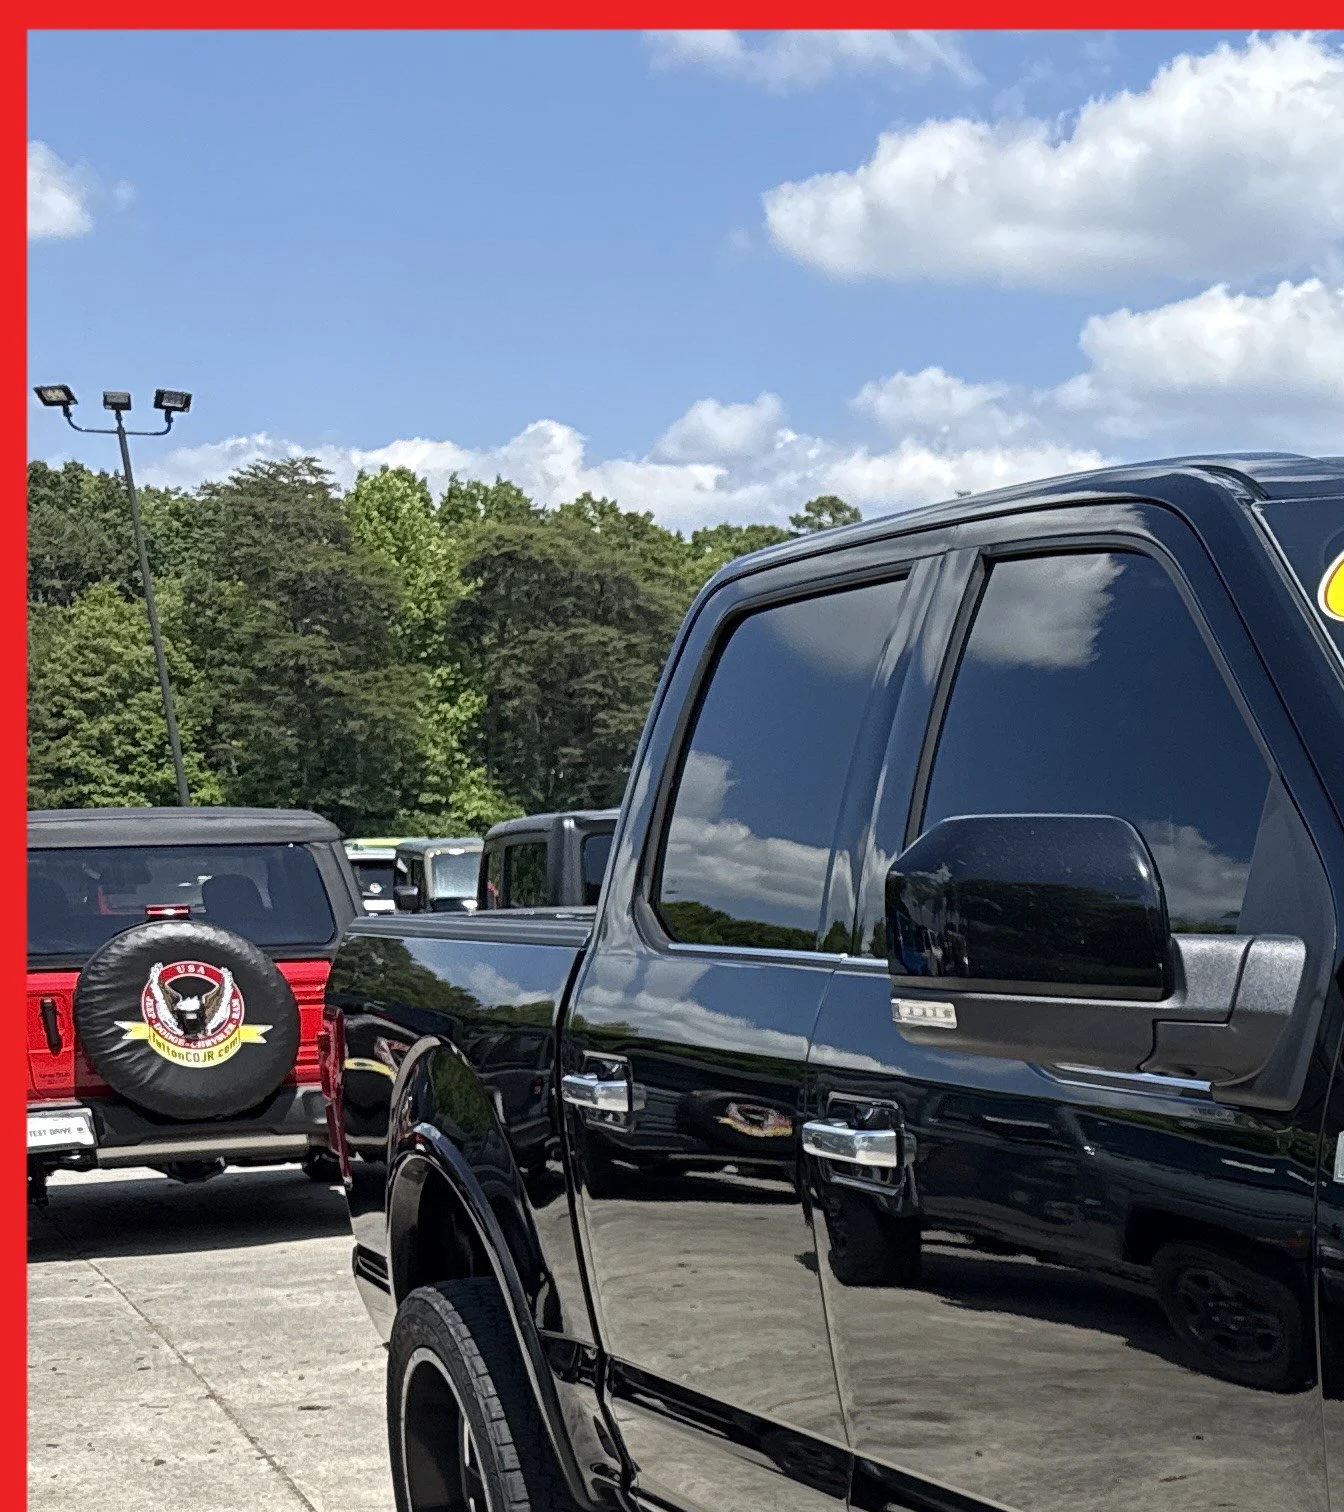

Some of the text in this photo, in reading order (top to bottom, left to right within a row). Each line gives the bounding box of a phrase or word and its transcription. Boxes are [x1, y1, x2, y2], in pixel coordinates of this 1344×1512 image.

[176, 964, 206, 975] USA
[29, 1127, 72, 1138] TEST DRIVE
